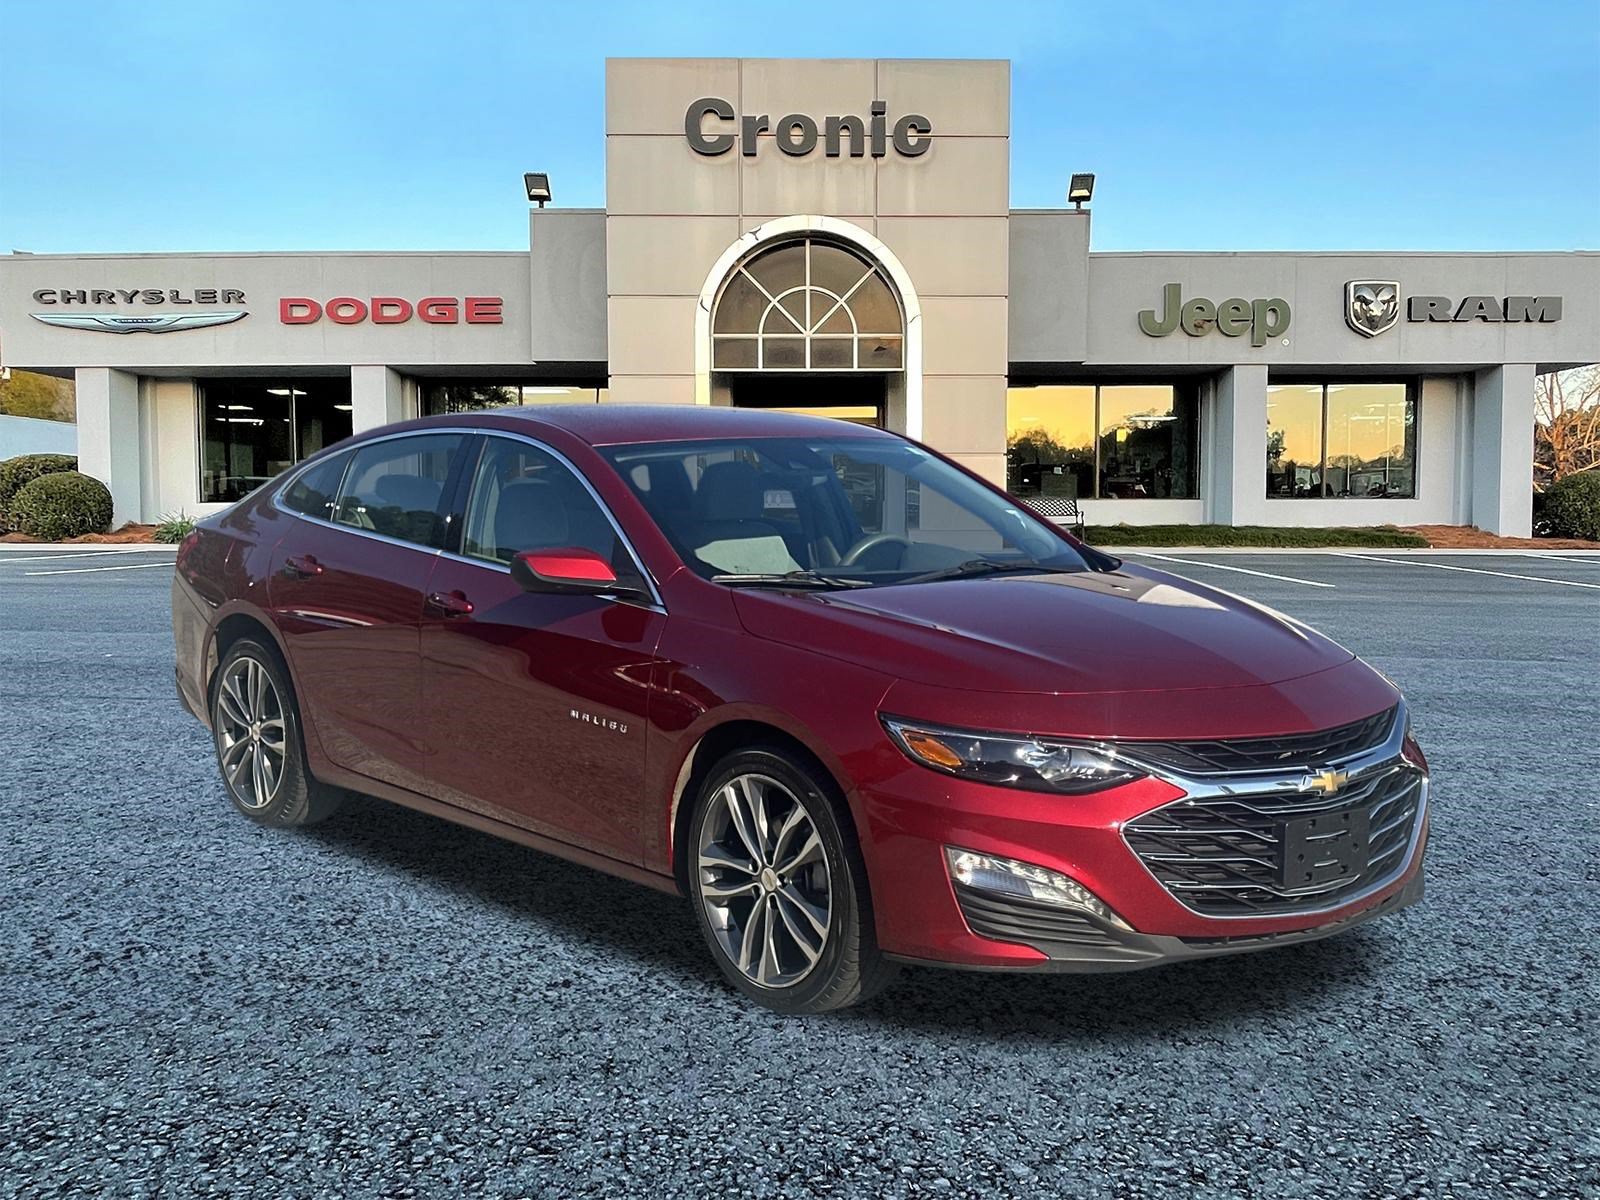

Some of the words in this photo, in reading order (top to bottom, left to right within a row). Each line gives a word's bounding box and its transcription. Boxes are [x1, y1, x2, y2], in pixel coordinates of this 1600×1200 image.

[685, 97, 932, 157] Cronic
[32, 289, 246, 304] CHRYSLER
[1407, 296, 1563, 322] RAM
[279, 297, 504, 325] DODGE
[1138, 283, 1291, 347] Jeep
[570, 709, 628, 733] MALIBU
